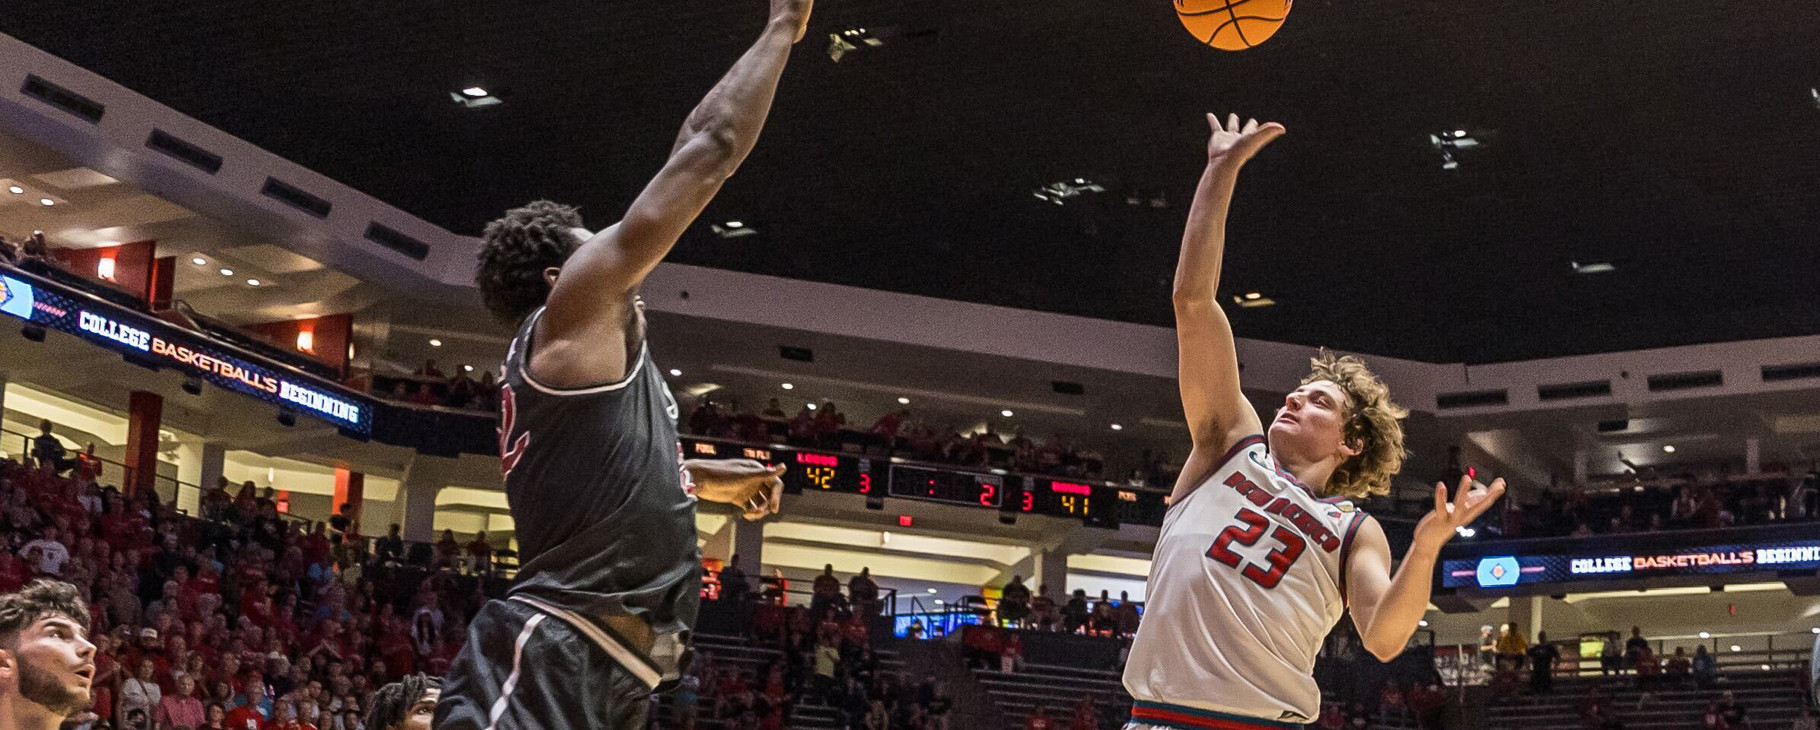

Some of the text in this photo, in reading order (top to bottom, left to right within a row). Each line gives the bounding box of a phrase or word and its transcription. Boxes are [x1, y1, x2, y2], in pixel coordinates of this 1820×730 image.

[79, 310, 359, 423] COLLEGE BASKETBALL'S BEGINNING
[806, 467, 836, 489] 42
[859, 473, 871, 494] 3
[980, 484, 995, 507] 2
[1022, 491, 1034, 511] 3
[1062, 495, 1090, 516] 41
[1205, 507, 1307, 589] 23
[1572, 557, 1632, 574] COLLEGE
[1633, 550, 1755, 571] BASKETBALL'S
